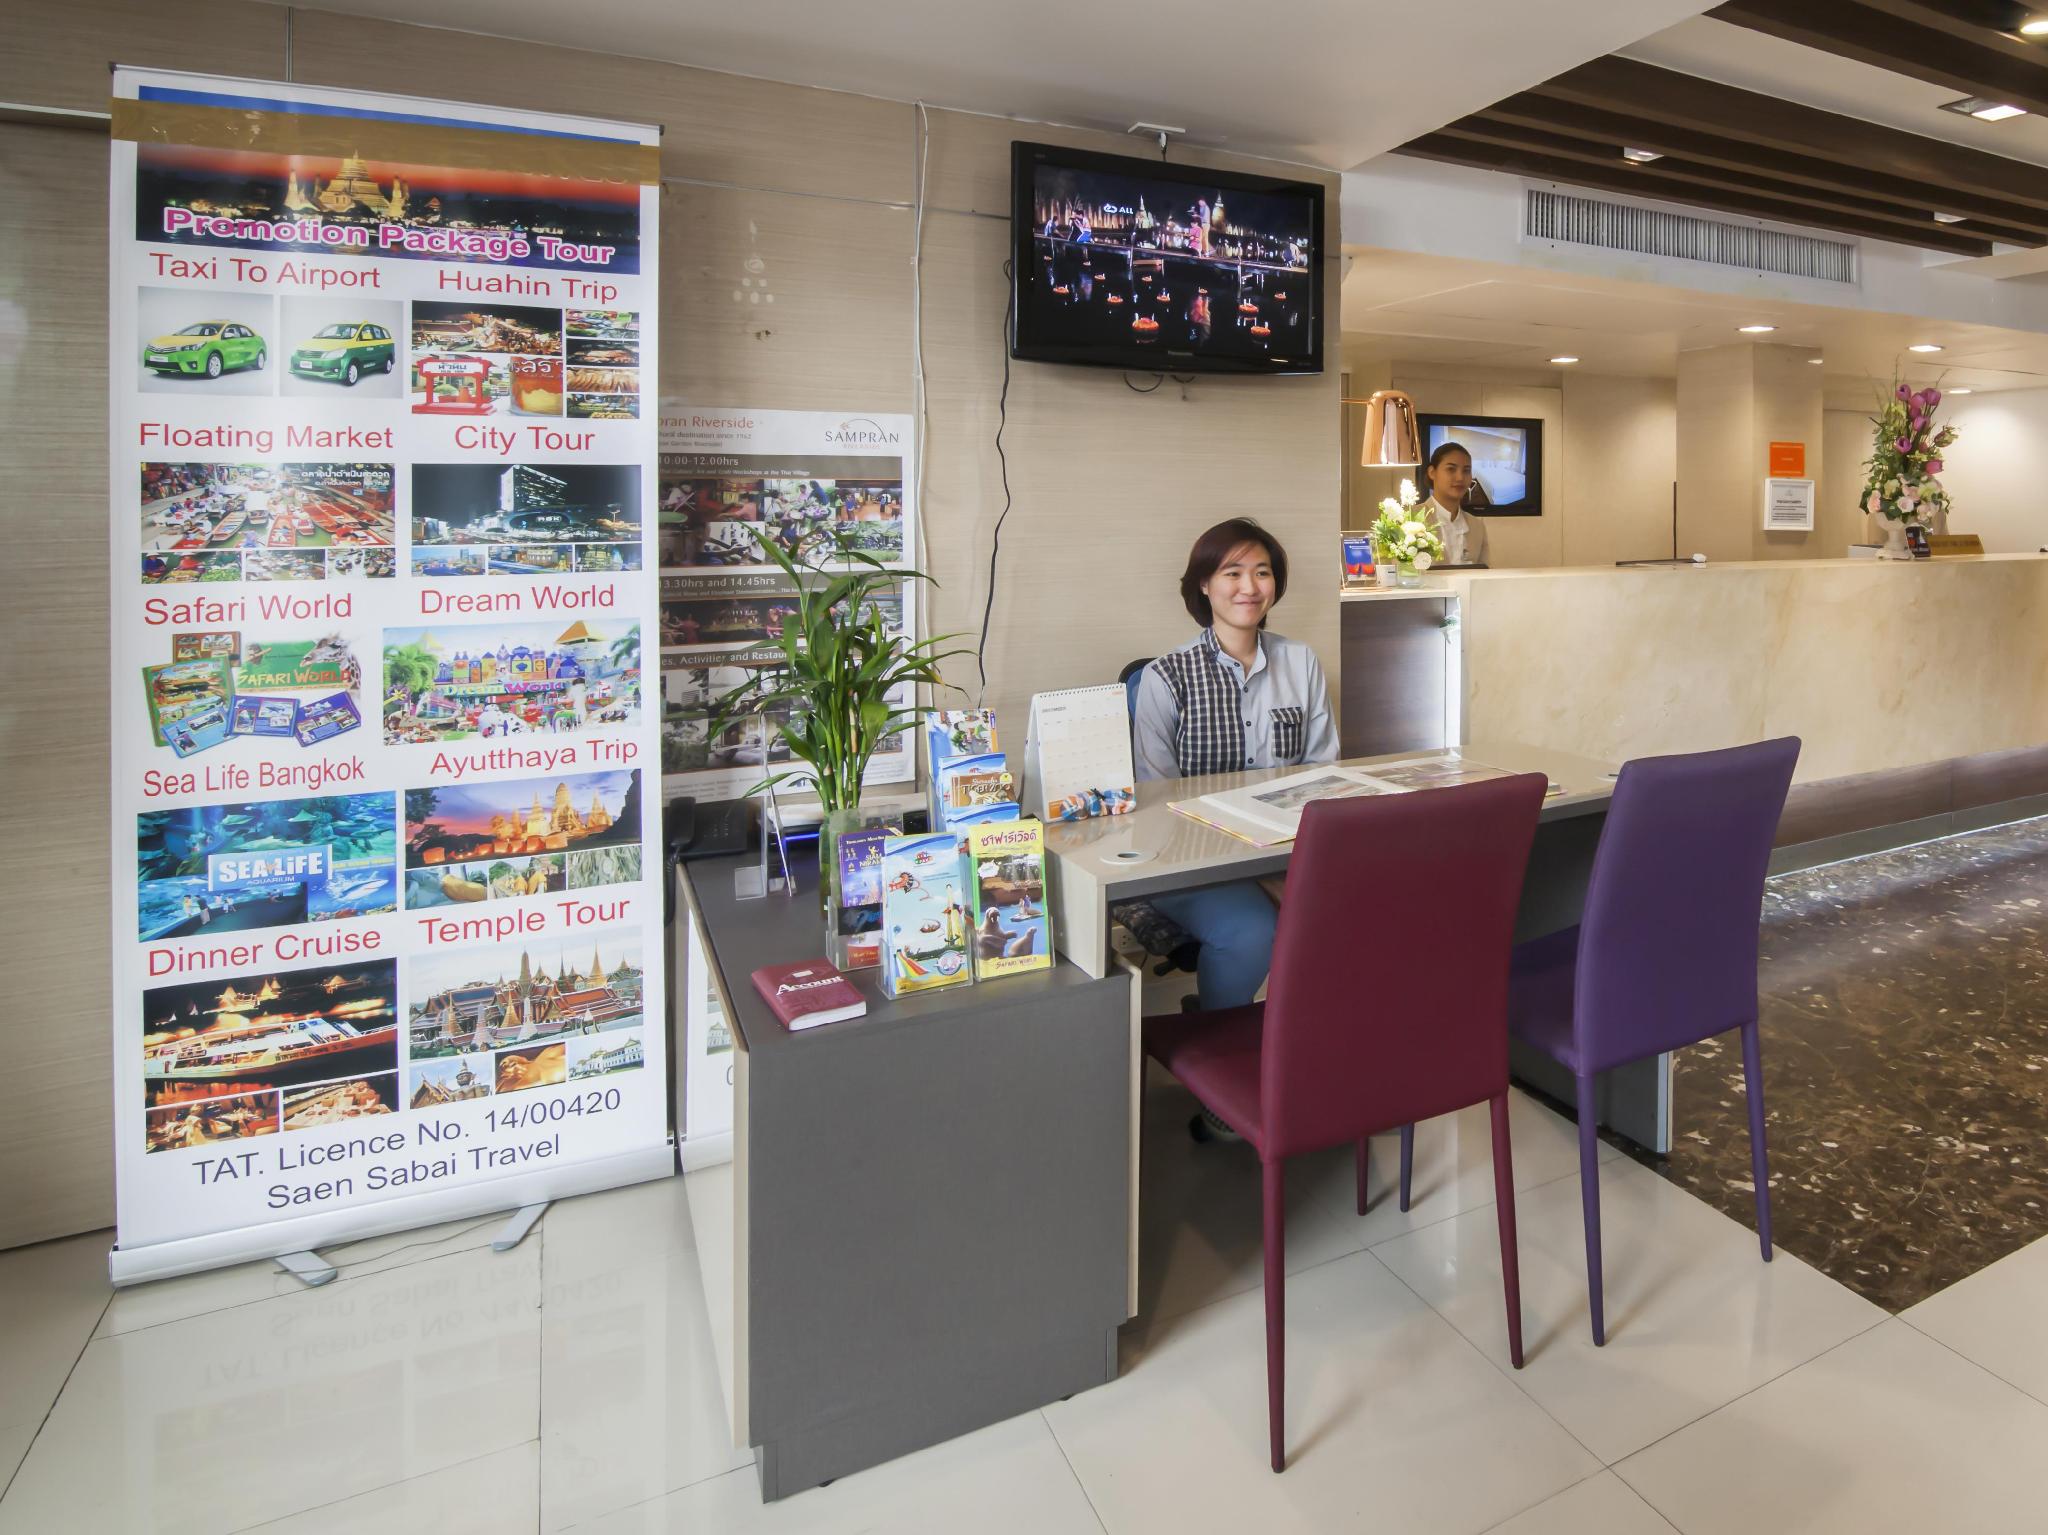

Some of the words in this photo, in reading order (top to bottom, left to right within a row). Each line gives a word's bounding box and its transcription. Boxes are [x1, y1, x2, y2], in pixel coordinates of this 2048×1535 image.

[1119, 206, 1133, 215] ALL
[164, 207, 369, 246] Promotion
[378, 224, 530, 262] Package
[538, 235, 616, 265] Tour
[149, 252, 217, 280] Taxi
[229, 257, 268, 283] To
[276, 262, 381, 291] Airport
[439, 269, 551, 296] Huahin
[561, 277, 618, 305] Trip
[692, 416, 754, 429] Riverside
[825, 430, 899, 443] SAMPRAN
[140, 423, 273, 453] Floating
[287, 425, 393, 448] Market
[455, 425, 517, 456] City
[527, 426, 595, 450] Tour
[708, 578, 727, 587] and
[730, 576, 776, 587] 14.45hrs
[144, 596, 245, 625] Safari
[259, 593, 352, 620] World
[421, 589, 521, 614] Dream
[531, 584, 614, 610] World
[730, 652, 749, 661] and
[239, 667, 291, 686] SAFARI
[293, 667, 352, 683] WORLD
[430, 746, 576, 779] Ayutthaya
[586, 738, 638, 763] Trip
[144, 770, 195, 797] Sea
[206, 764, 249, 791] Life
[259, 755, 365, 791] Bangkok
[219, 858, 268, 883] SEA
[247, 876, 295, 886] AQUARIUM
[418, 908, 546, 945] Temple
[558, 900, 631, 927] Tour
[149, 944, 264, 977] Dinner
[275, 929, 381, 961] Cruise
[776, 976, 844, 995] Account
[192, 1151, 264, 1185] TAT.
[279, 1133, 406, 1171] Licence
[418, 1120, 469, 1146] No.
[485, 1088, 621, 1133] 14/00420
[267, 1178, 353, 1209] Saen
[367, 1152, 456, 1190] Sabai
[468, 1133, 559, 1170] Travel
